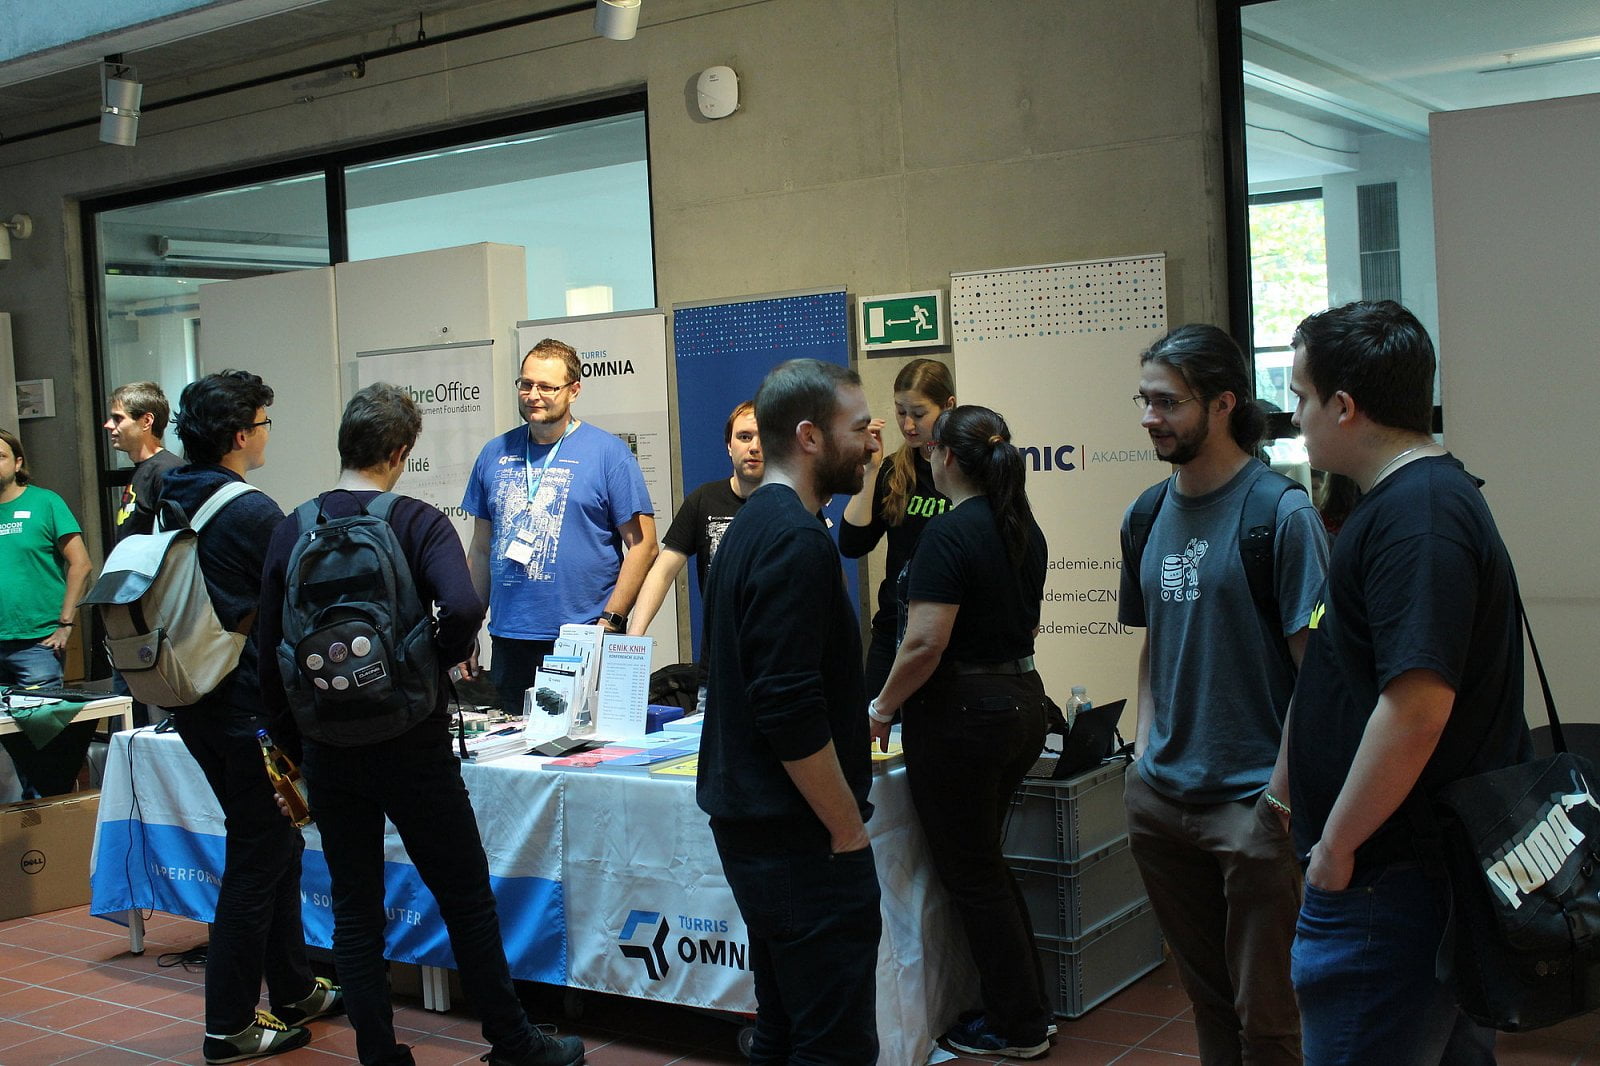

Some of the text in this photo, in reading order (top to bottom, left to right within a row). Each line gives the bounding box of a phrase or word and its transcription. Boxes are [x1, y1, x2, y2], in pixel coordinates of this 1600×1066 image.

[581, 351, 607, 359] TURRIS
[581, 360, 635, 378] OMNIA
[407, 457, 430, 472] lidé
[1047, 557, 1123, 570] ademie.nic
[1043, 589, 1119, 602] demieCZN
[1486, 803, 1586, 910] PUMA
[678, 915, 728, 933] TURRIS
